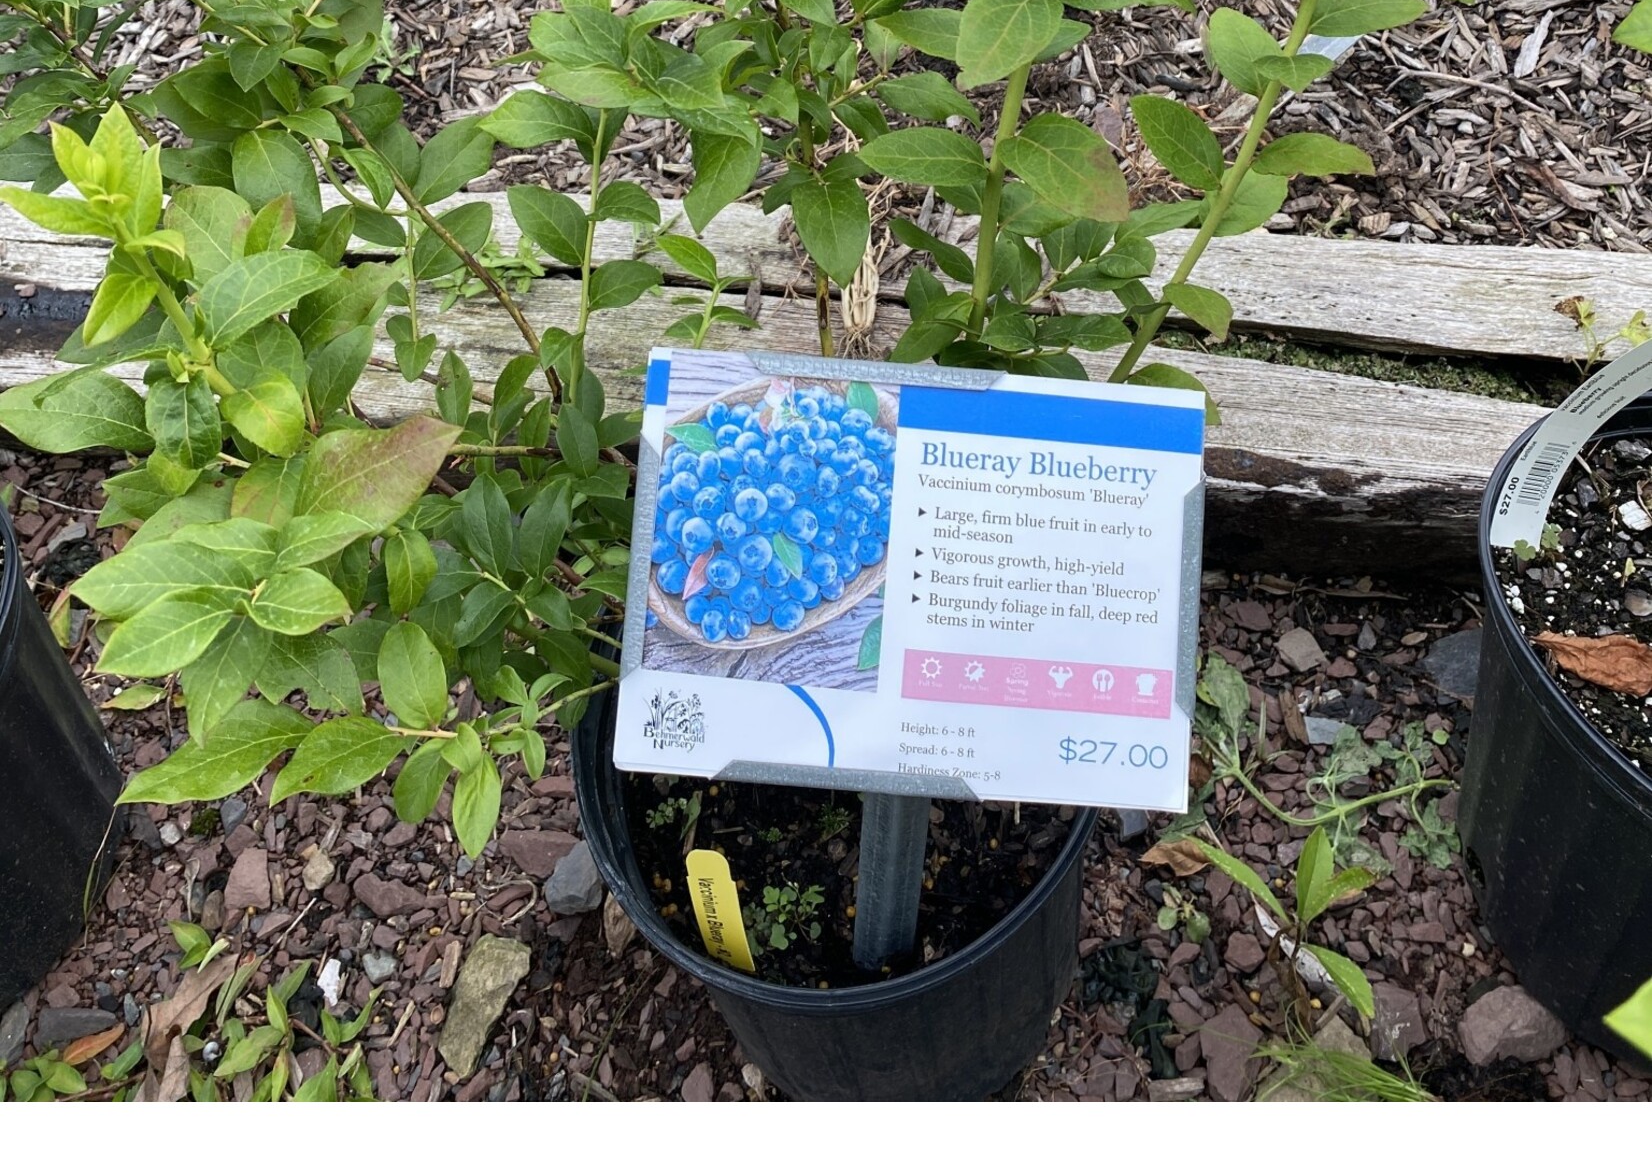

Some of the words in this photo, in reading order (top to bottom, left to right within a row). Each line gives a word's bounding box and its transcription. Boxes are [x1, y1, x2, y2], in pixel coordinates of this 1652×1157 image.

[1570, 388, 1602, 413] Blueberry
[921, 442, 1020, 478] Blueray
[1029, 452, 1157, 491] Blueberry
[919, 474, 991, 493] Vaccinium
[996, 484, 1085, 501] corymbosum
[1090, 488, 1150, 508] 'Blueray'
[1499, 476, 1520, 516] $27.00
[934, 526, 1013, 544] mid-season
[935, 507, 977, 525] Large,
[982, 510, 1011, 526] firm
[1016, 513, 1045, 528] blue
[1049, 516, 1079, 532] fruit
[1084, 519, 1096, 533] in
[1101, 521, 1134, 538] early
[1139, 526, 1152, 537] to
[932, 547, 993, 567] Vigorous
[997, 553, 1051, 573] growth,
[1055, 558, 1124, 577] high-yield
[930, 571, 969, 586] Bears
[973, 574, 1003, 589] fruit
[1007, 577, 1052, 593] earlier
[1056, 580, 1087, 595] than
[1092, 583, 1160, 603] 'Bluecrop'
[927, 613, 967, 628] stems
[972, 615, 985, 629] in
[989, 617, 1034, 632] winter
[929, 593, 997, 614] Burgundy
[1001, 598, 1047, 617] foliage
[1052, 603, 1064, 616] in
[1069, 604, 1094, 621] fall,
[1099, 607, 1131, 625] deep
[1136, 611, 1158, 624] red
[901, 722, 938, 736] Height:
[942, 726, 948, 735] 6
[958, 727, 965, 736] 8
[967, 728, 975, 737] ft
[653, 738, 696, 753] Nursery
[899, 742, 938, 755] Spread:
[941, 747, 948, 756] 6
[957, 747, 964, 758] 8
[967, 748, 975, 758] ft
[1058, 735, 1168, 770] $27.00
[898, 763, 950, 776] Hardiness
[952, 767, 981, 779] Zone:
[983, 771, 1000, 781] 5-8
